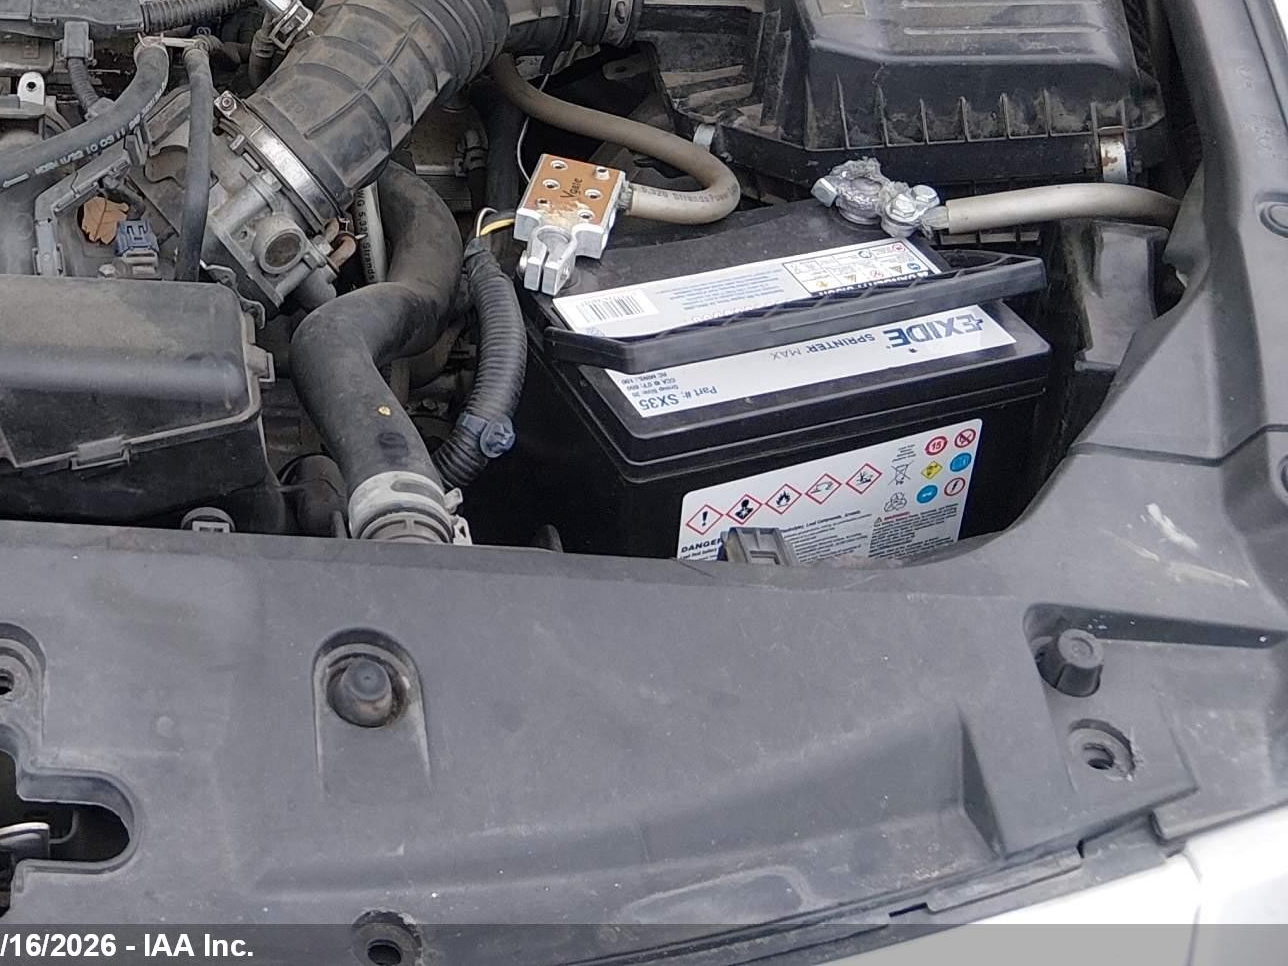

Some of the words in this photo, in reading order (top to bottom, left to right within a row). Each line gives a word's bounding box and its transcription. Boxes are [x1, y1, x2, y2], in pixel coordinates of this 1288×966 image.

[883, 313, 983, 348] EXIDE
[808, 333, 875, 352] SPRINTER
[770, 348, 801, 361] MAX
[694, 385, 717, 396] Part
[639, 393, 679, 410] SX35
[931, 441, 942, 451] 15
